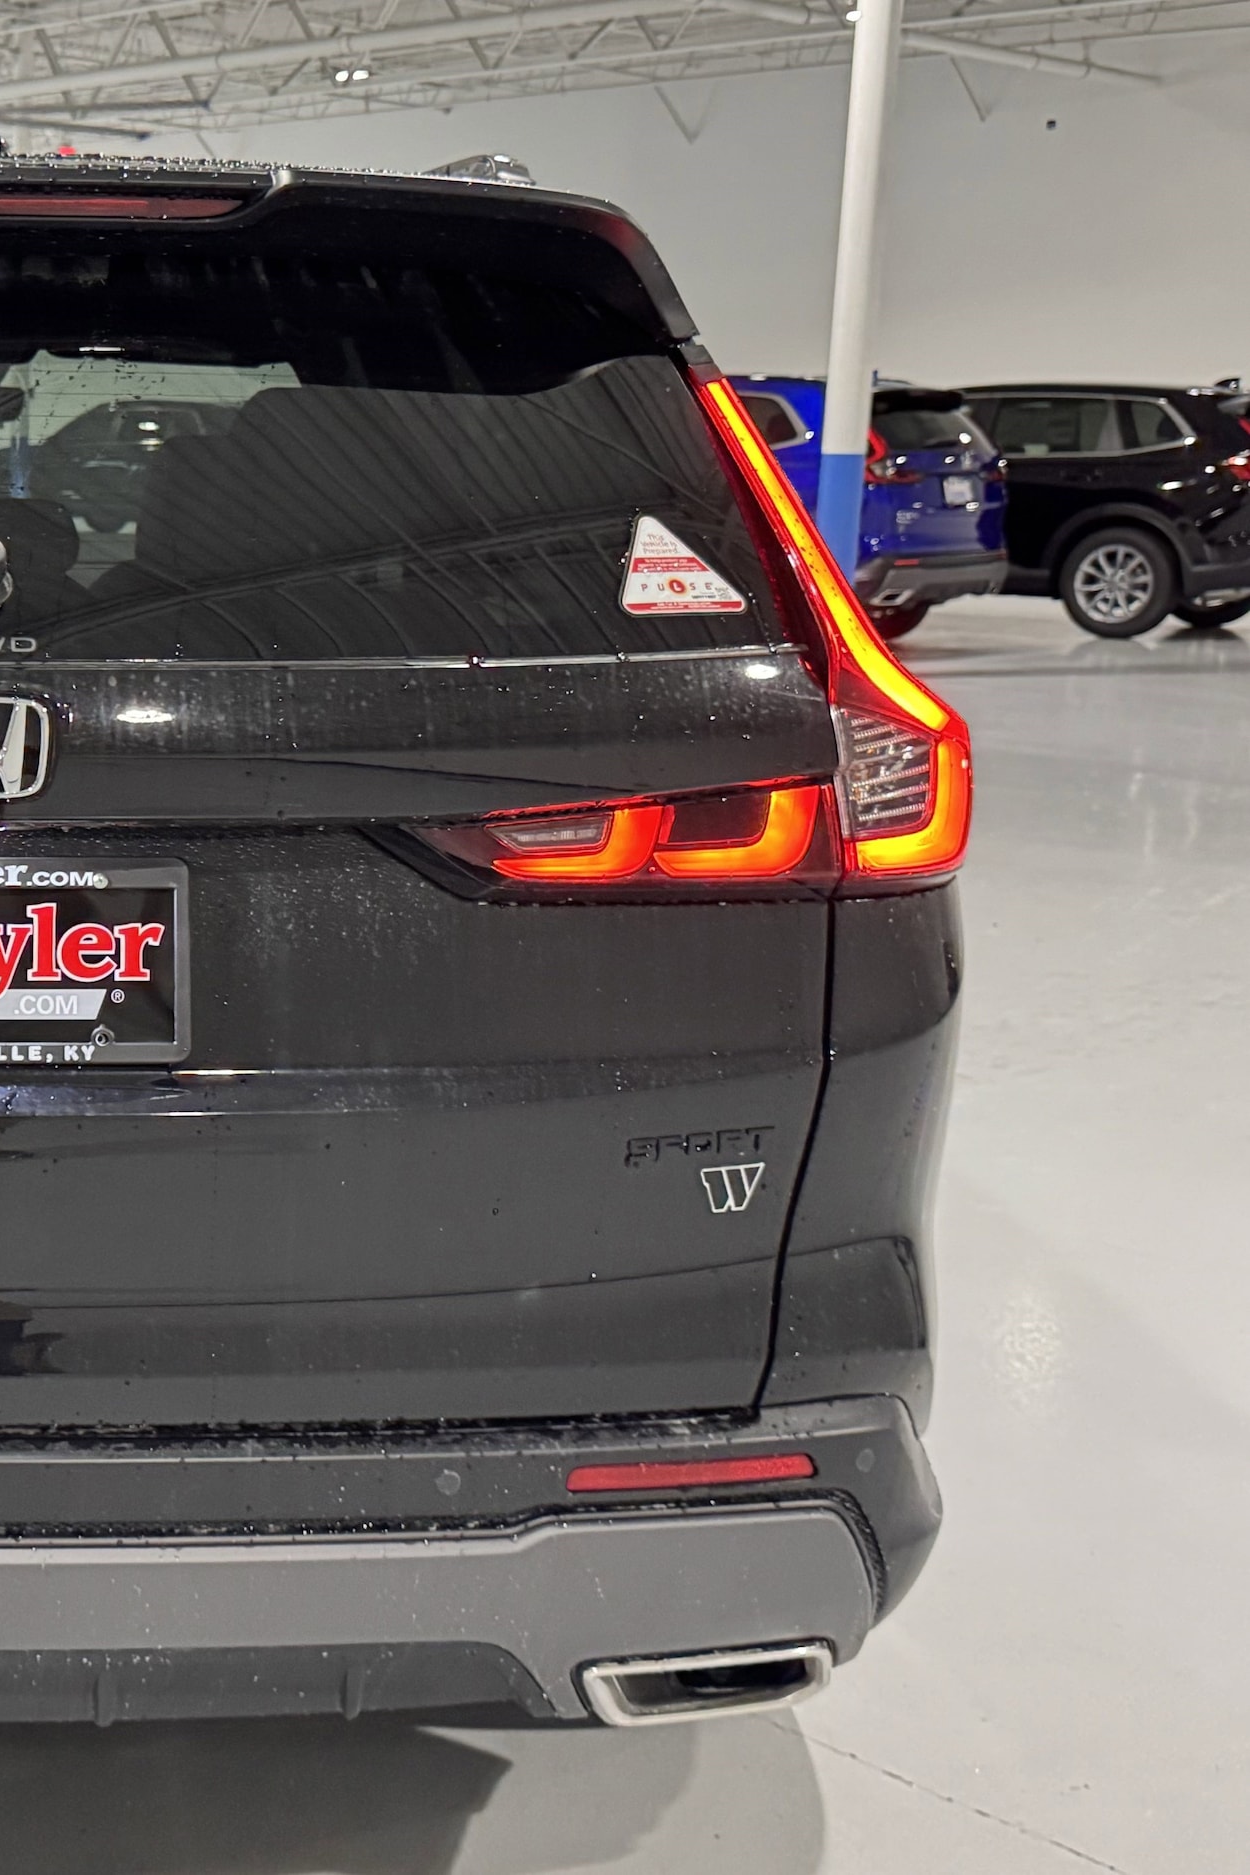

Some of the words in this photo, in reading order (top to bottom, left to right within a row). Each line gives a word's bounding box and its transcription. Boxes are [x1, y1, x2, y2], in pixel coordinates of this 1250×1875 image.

[640, 578, 713, 595] PULSE
[13, 994, 79, 1016] .COM
[63, 1044, 96, 1062] KY
